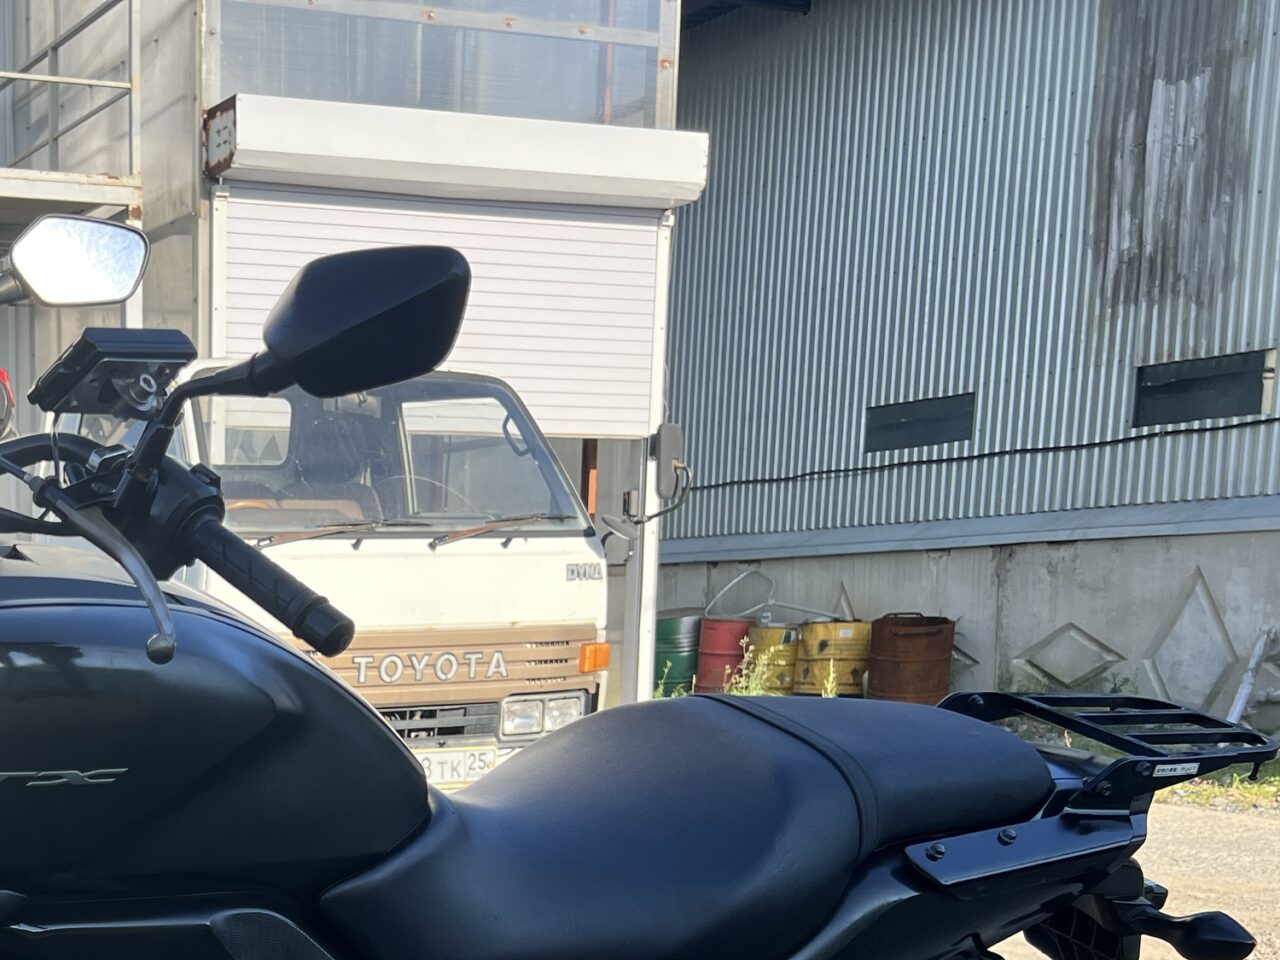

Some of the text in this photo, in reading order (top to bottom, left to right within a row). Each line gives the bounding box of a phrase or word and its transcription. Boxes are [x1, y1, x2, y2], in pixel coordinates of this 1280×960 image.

[566, 563, 603, 581] DYNA
[352, 651, 508, 684] TOYOTA
[468, 753, 487, 770] 25
